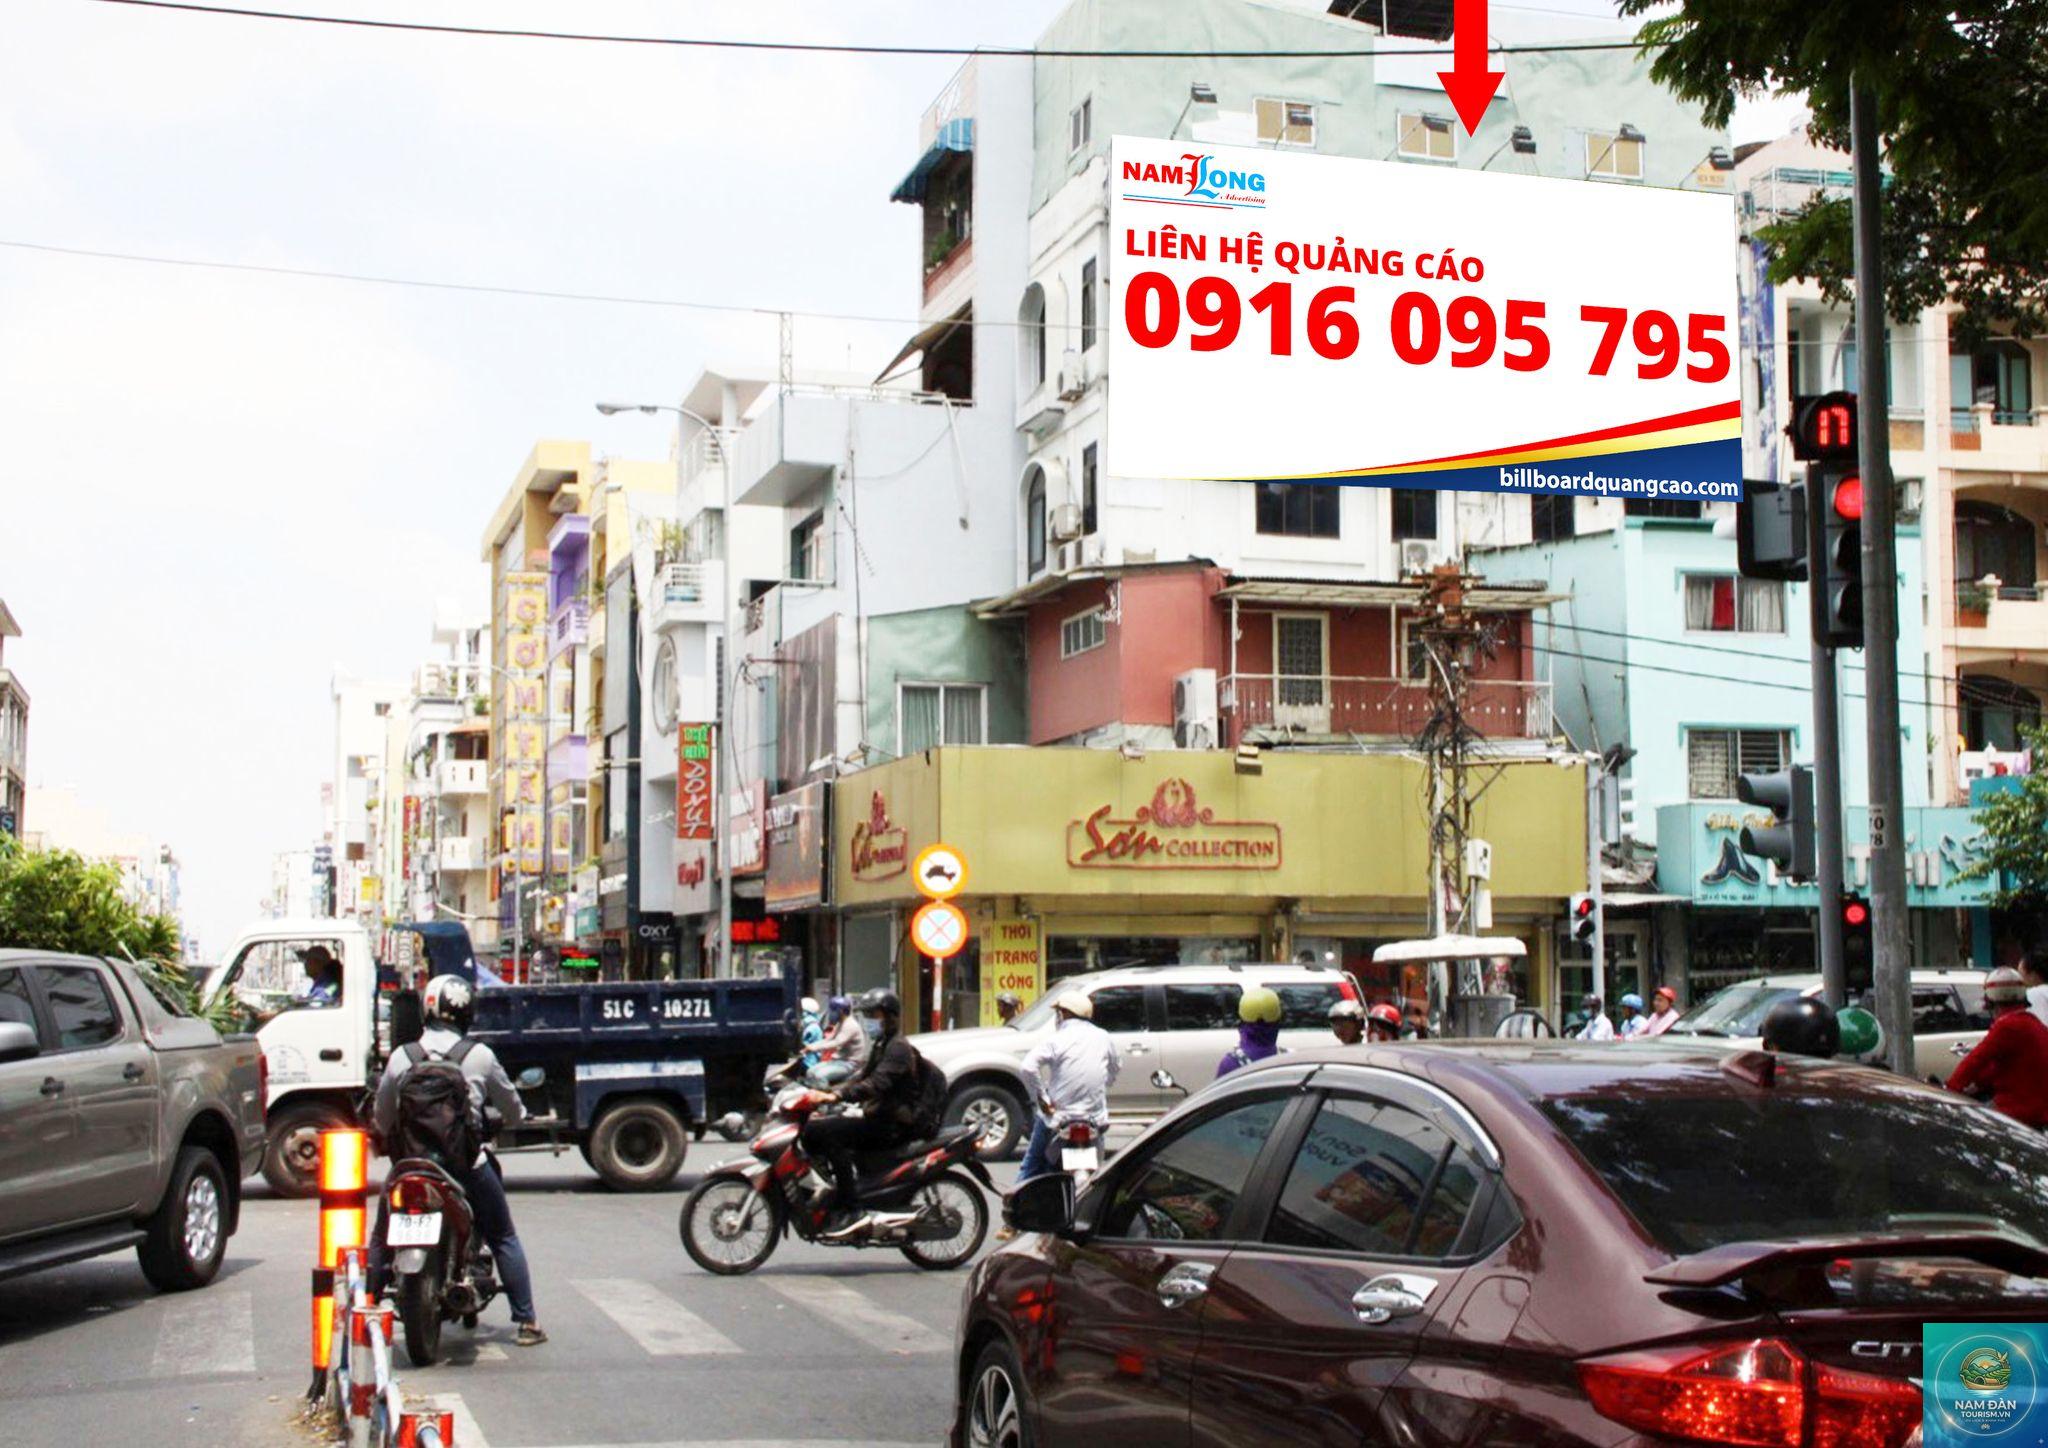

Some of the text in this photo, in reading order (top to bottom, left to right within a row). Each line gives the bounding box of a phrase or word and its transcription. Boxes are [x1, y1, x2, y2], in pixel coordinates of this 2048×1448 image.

[1123, 161, 1183, 185] NAM
[1126, 225, 1485, 284] LIÊN HỆ QUẢNG CÁO
[1124, 271, 1731, 384] 0916 095 795
[1500, 466, 1740, 499] billboardquangcao.com
[1166, 839, 1274, 858] COLLECTION
[639, 924, 671, 938] OXY
[603, 1000, 635, 1018] 51C
[664, 999, 712, 1018] 10271
[1851, 1341, 1922, 1357] CIT
